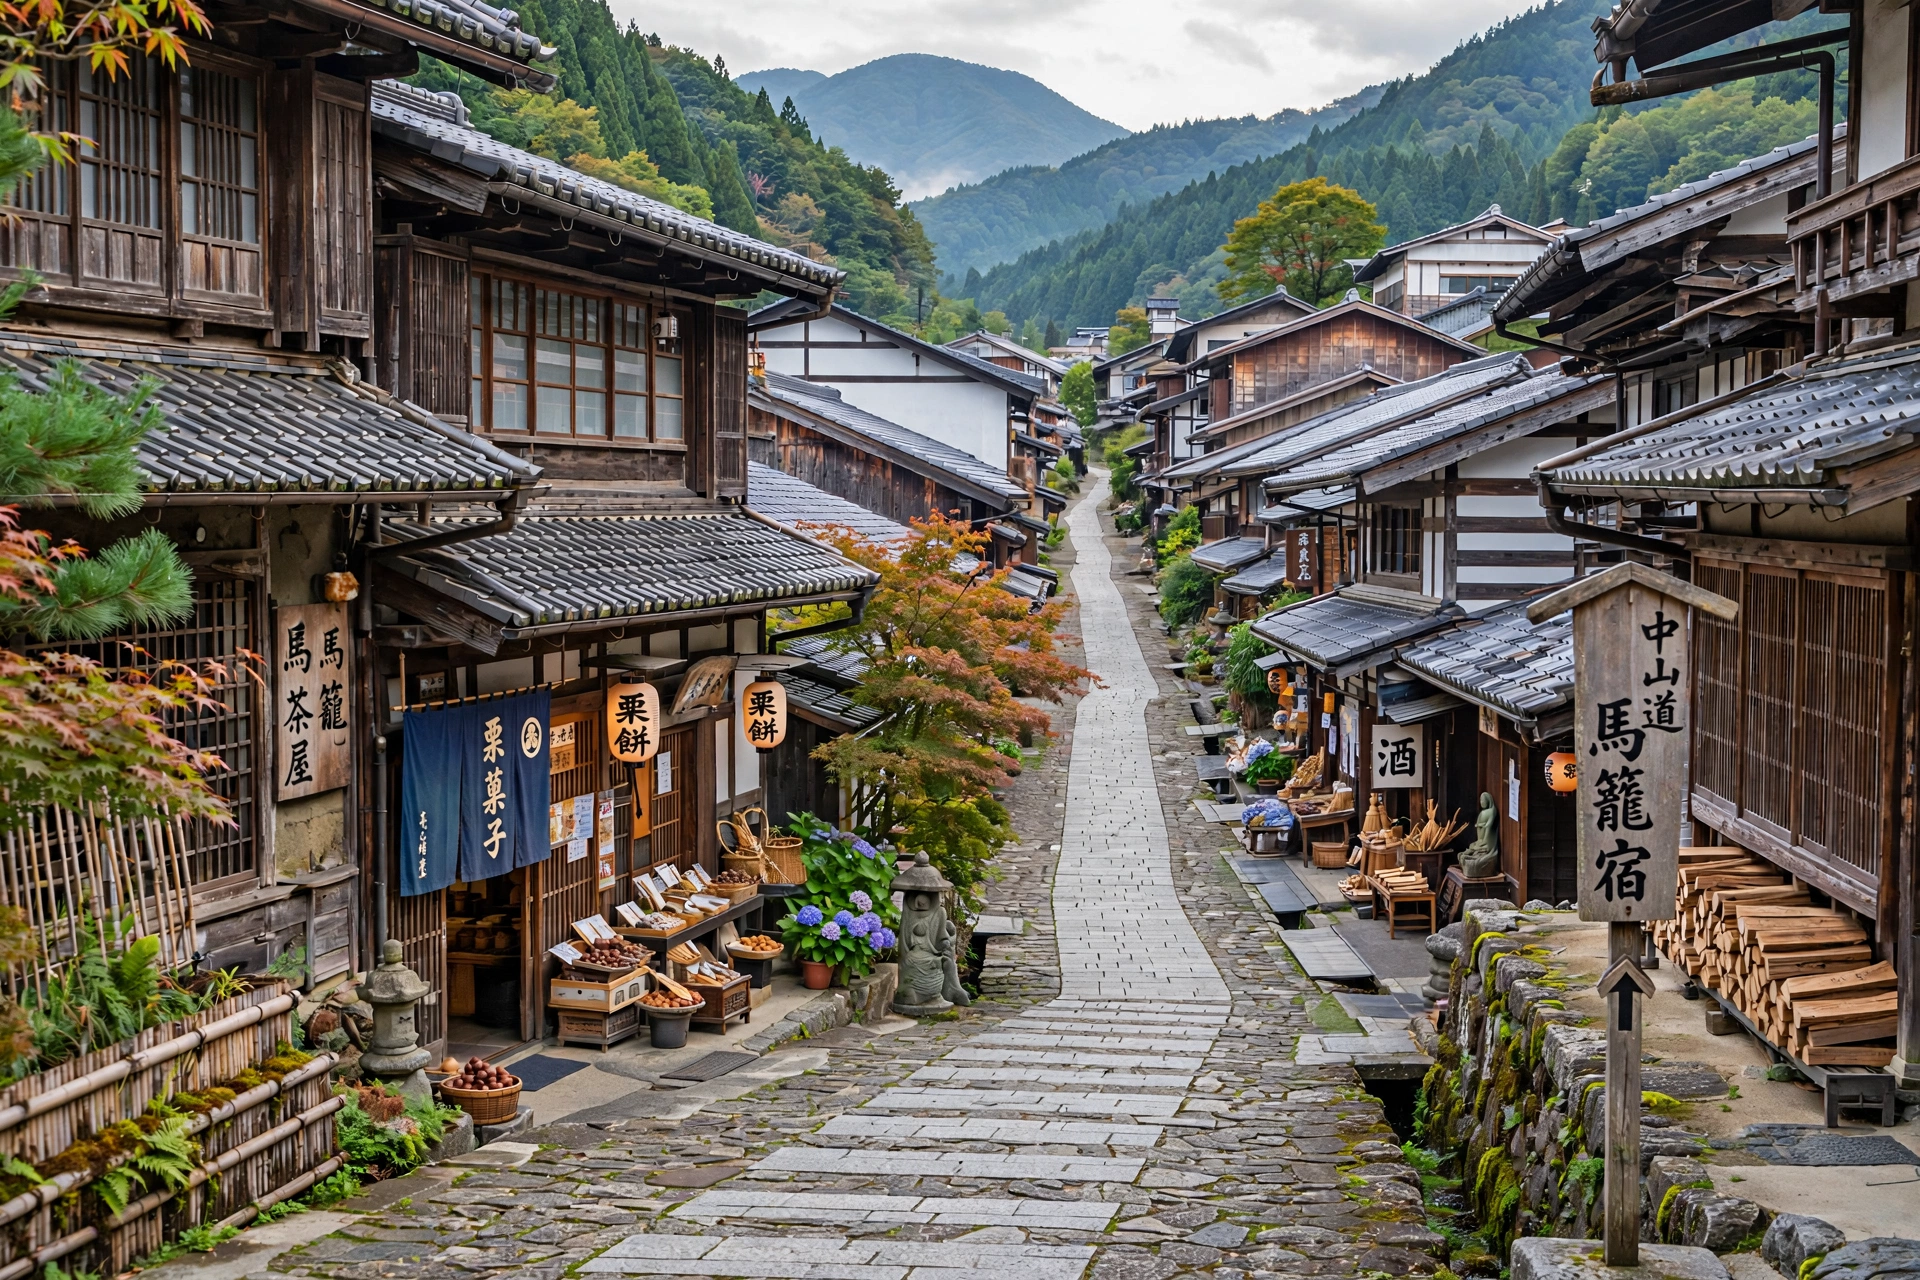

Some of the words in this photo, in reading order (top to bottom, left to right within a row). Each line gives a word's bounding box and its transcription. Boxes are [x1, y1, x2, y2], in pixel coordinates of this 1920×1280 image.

[283, 622, 313, 787] 馬茶屋
[317, 625, 347, 731] 馬籠
[1641, 611, 1684, 733] 中山道
[482, 716, 507, 859] 栗菓子
[1378, 737, 1417, 777] 酒
[1589, 698, 1653, 903] 馬籠宿
